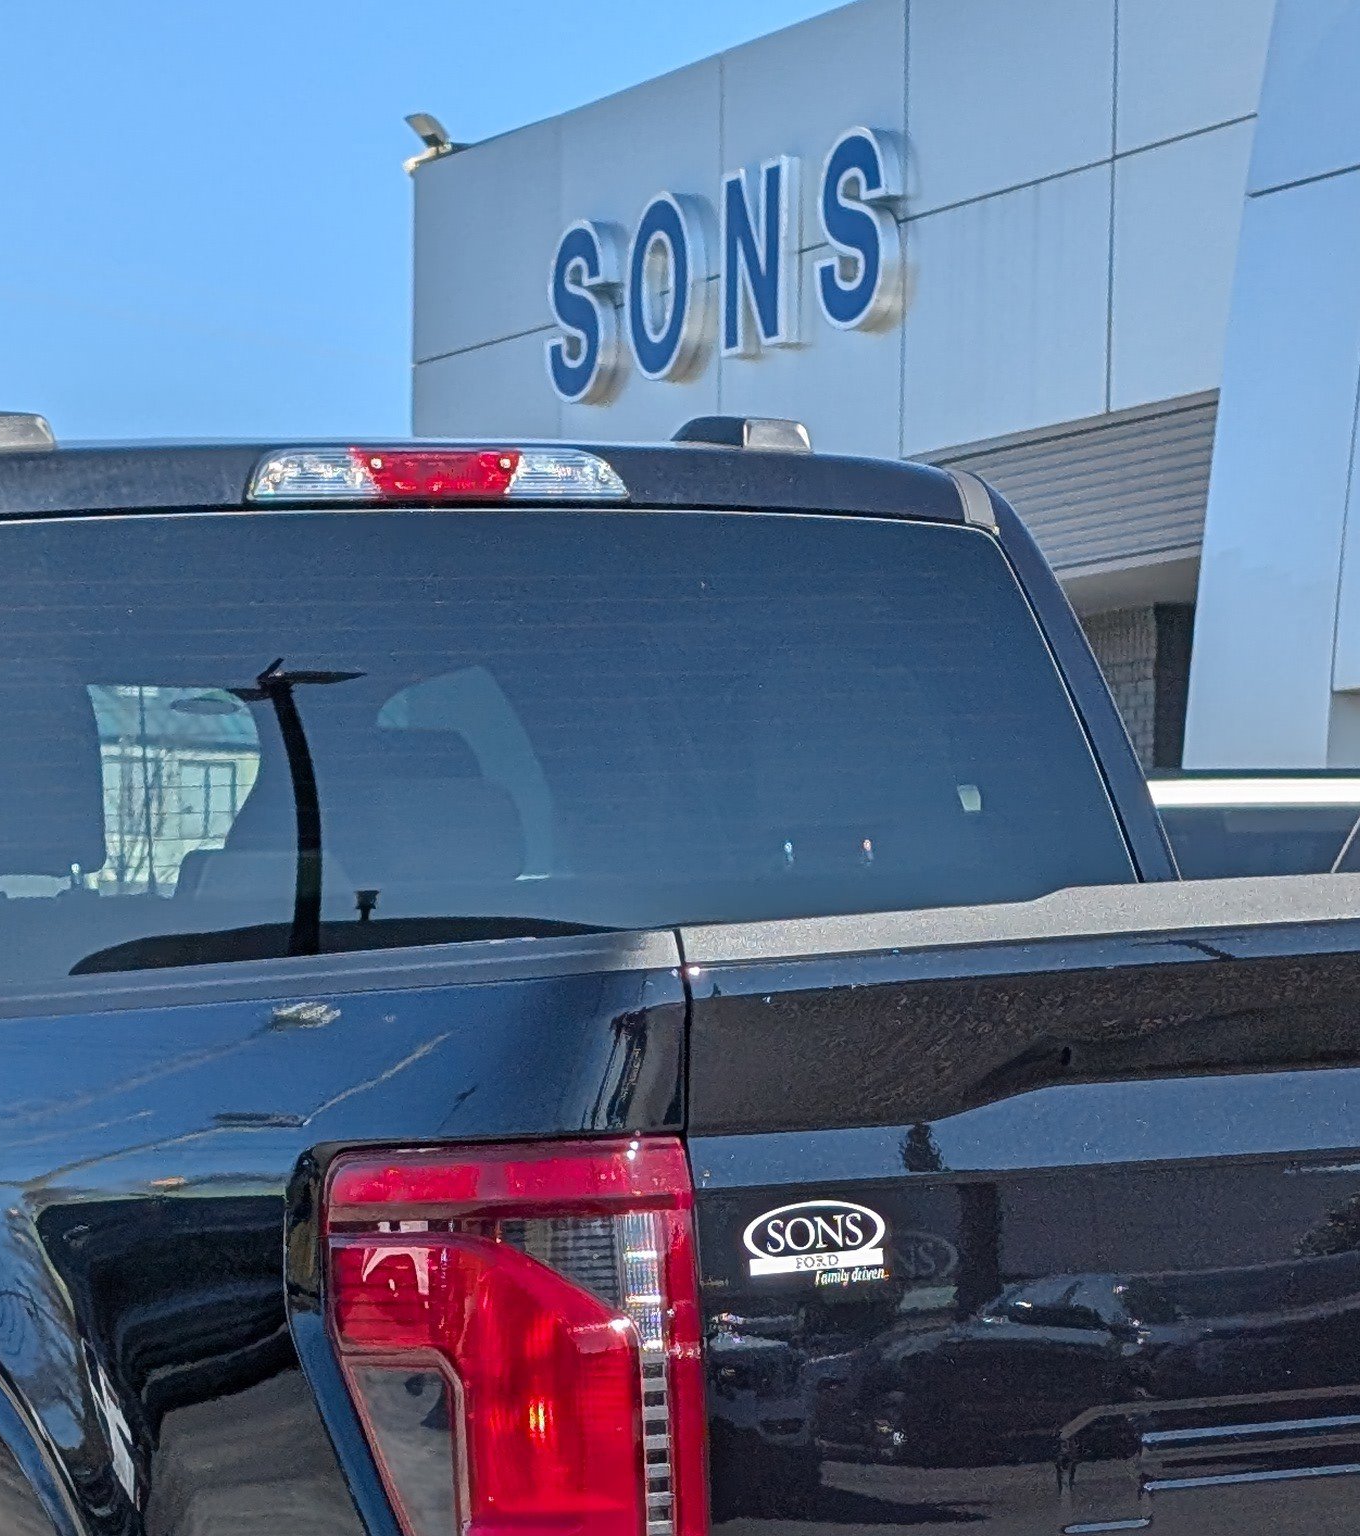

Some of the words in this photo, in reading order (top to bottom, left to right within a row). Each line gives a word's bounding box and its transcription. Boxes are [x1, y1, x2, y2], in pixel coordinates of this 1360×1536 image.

[544, 126, 900, 406] SONS
[766, 1212, 864, 1253] SONS
[795, 1253, 840, 1270] FORD
[814, 1268, 851, 1288] Family
